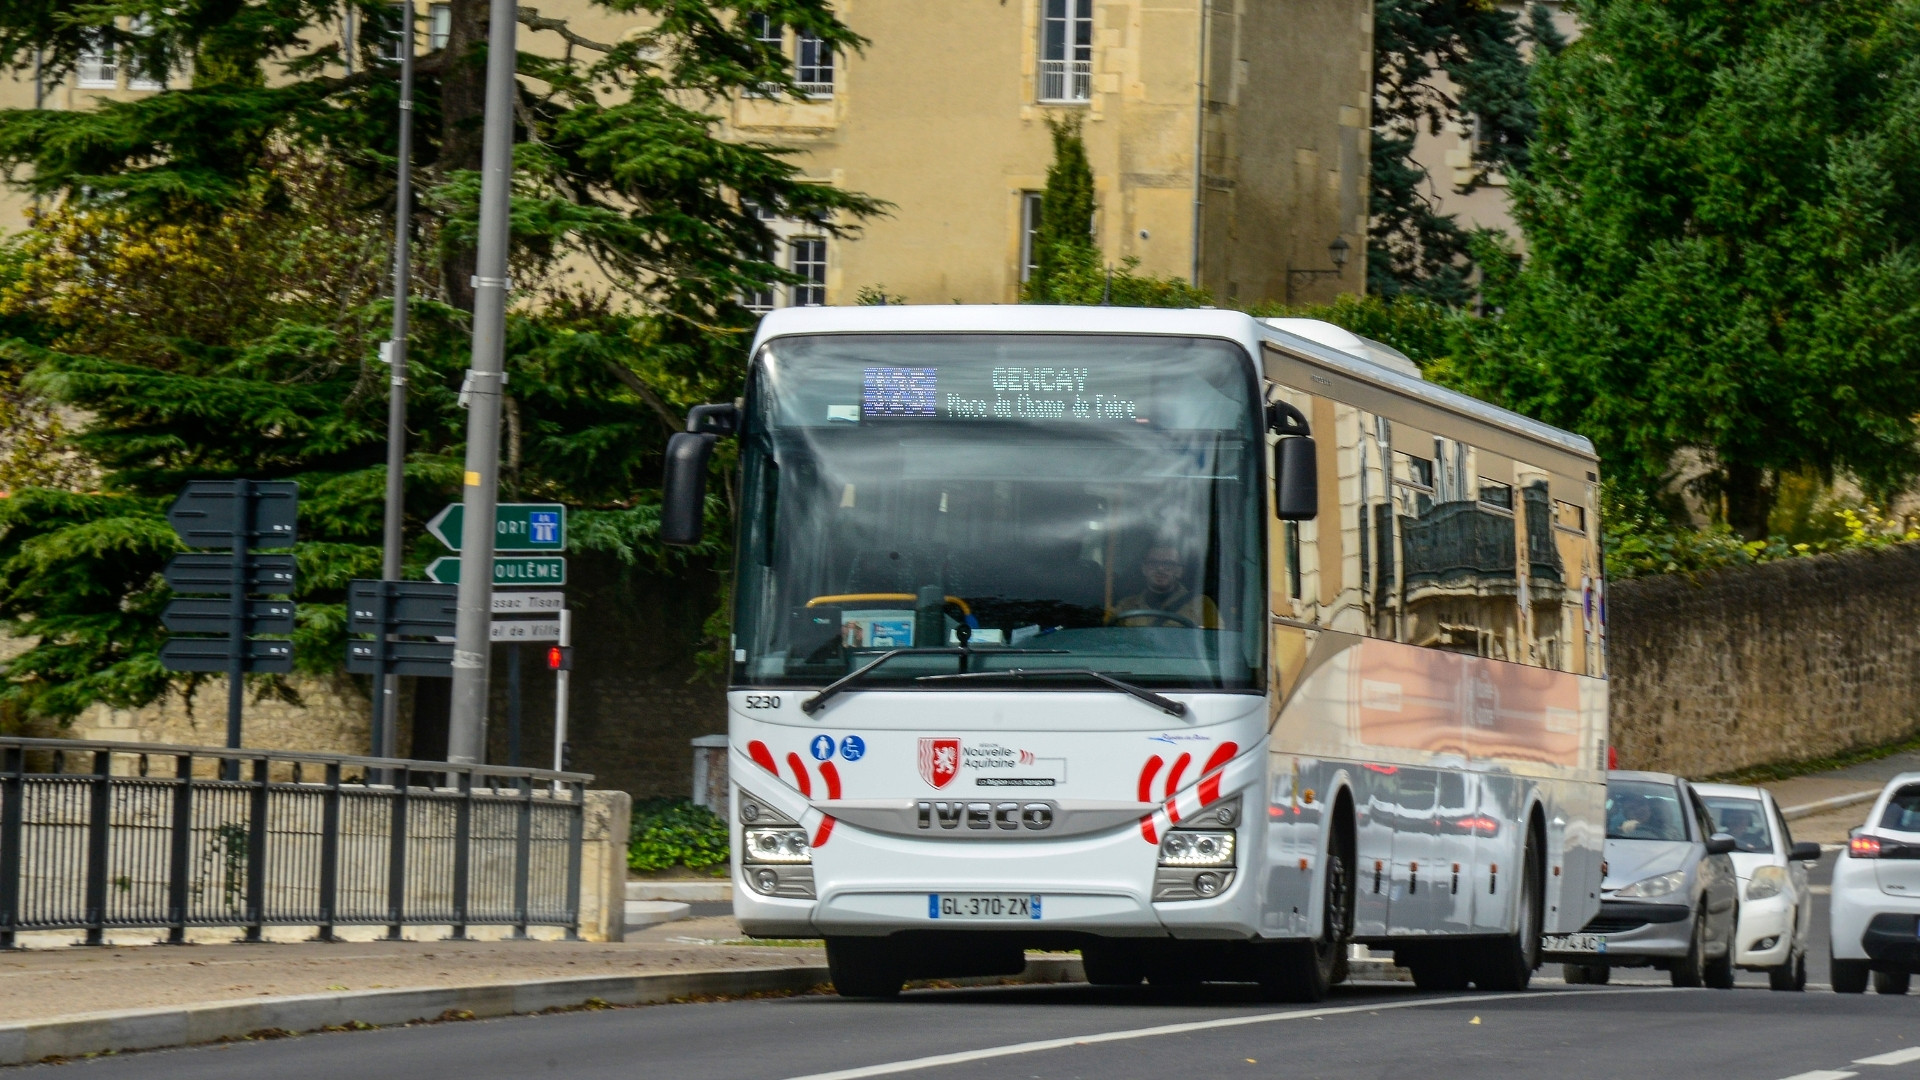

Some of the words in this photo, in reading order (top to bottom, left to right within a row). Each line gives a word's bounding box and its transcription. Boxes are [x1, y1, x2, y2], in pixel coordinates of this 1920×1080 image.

[993, 368, 1087, 391] GENCAY
[947, 393, 987, 418] Place
[993, 393, 1012, 418] du
[1018, 393, 1066, 418] Champ
[1072, 394, 1090, 418] de
[1096, 394, 1136, 419] Foire
[497, 520, 527, 535] ORT
[746, 695, 781, 709] 5230
[962, 747, 1016, 757] Nouvelle-
[963, 758, 1016, 770] Aquitaine
[918, 802, 1053, 830] IVECO
[942, 898, 1028, 915] GL-370-ZX
